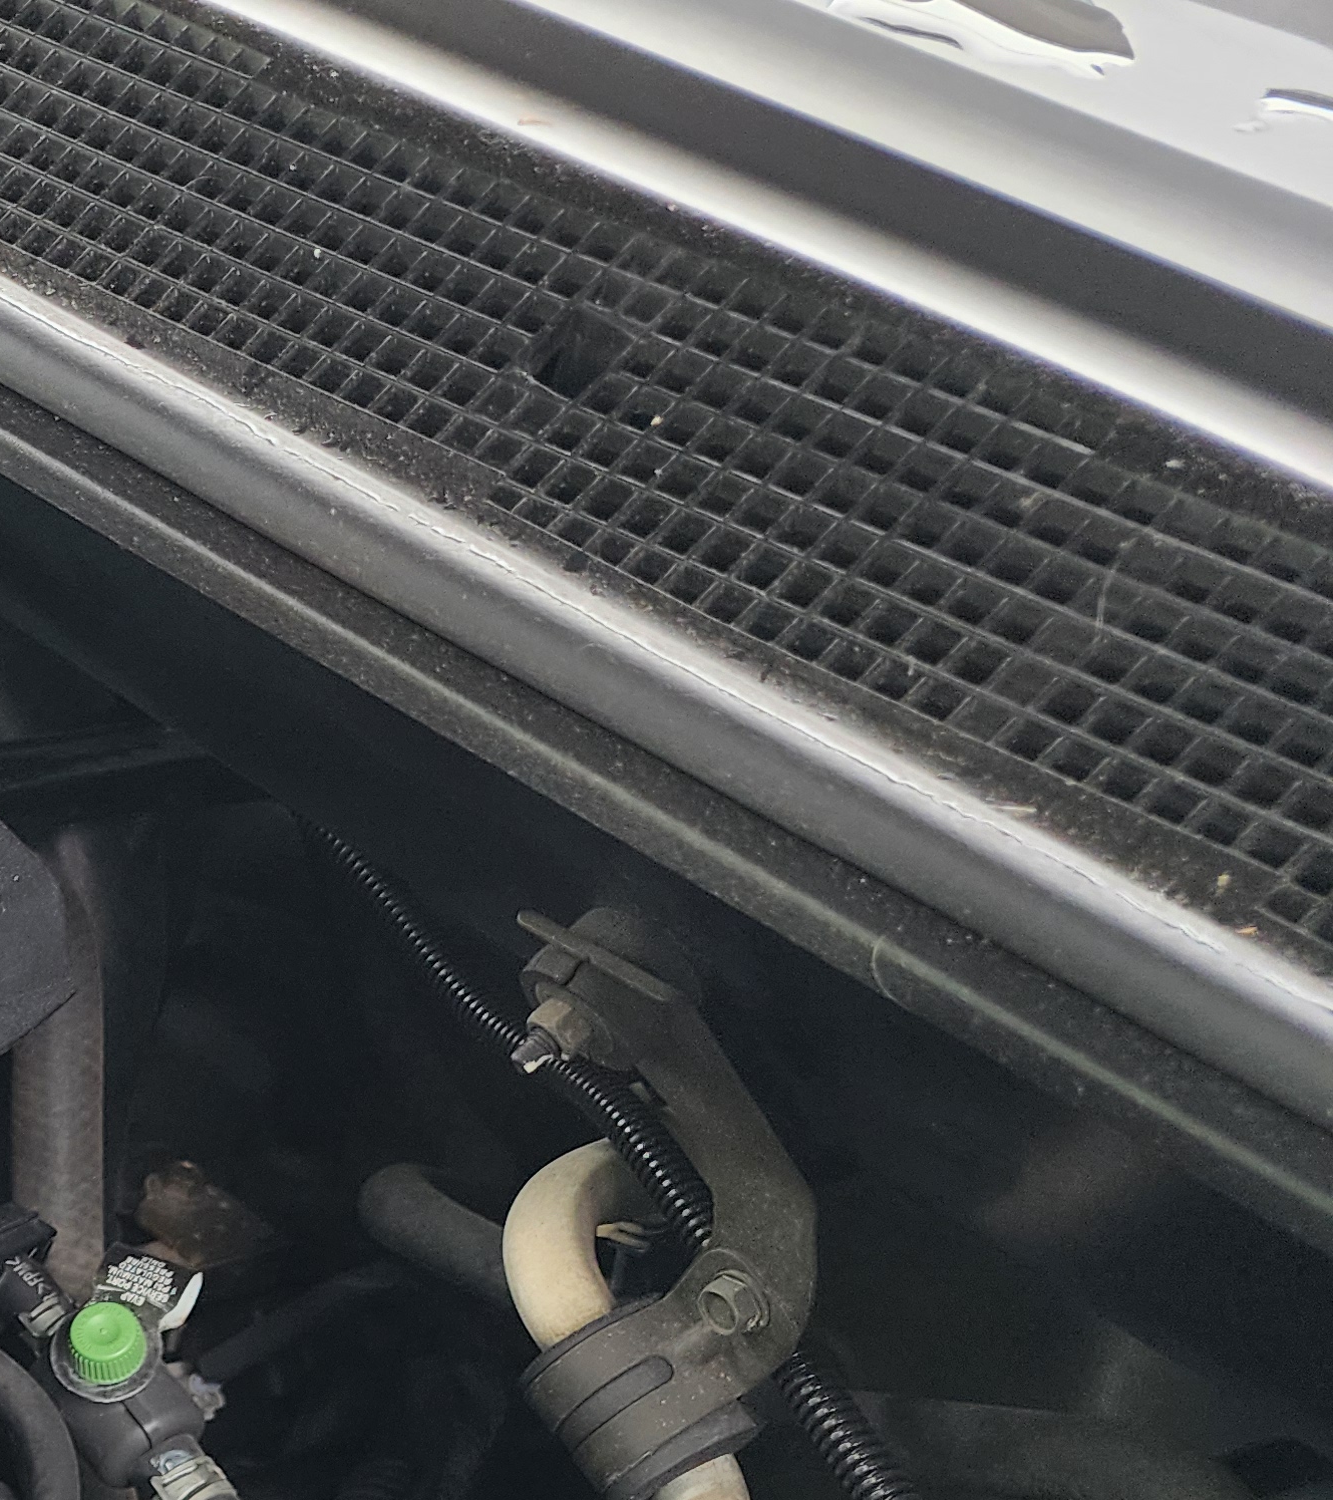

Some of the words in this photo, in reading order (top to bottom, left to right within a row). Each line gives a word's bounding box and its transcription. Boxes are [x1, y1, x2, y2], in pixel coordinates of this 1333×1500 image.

[118, 1261, 174, 1286] REGULATED
[120, 1292, 146, 1306] EVAP
[131, 1283, 171, 1303] SERVICE
